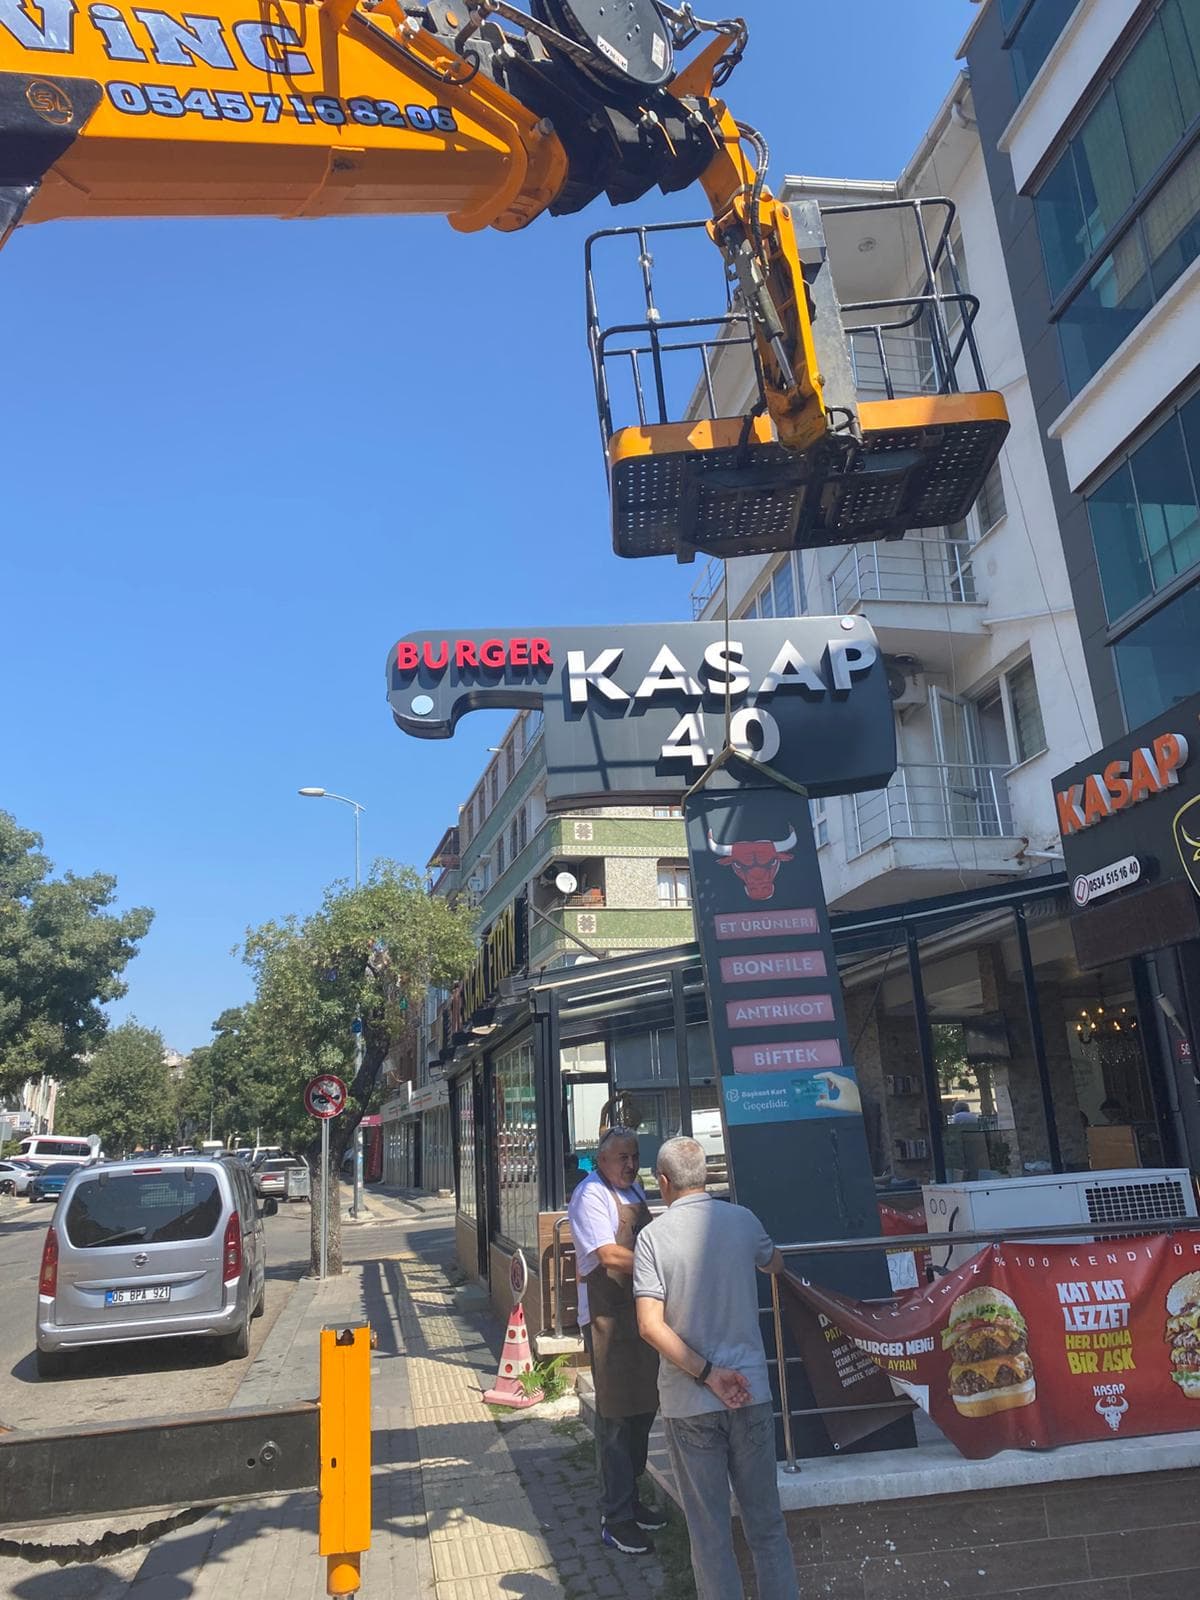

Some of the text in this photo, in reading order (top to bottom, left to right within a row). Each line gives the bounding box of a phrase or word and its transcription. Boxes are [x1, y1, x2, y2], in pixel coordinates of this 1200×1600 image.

[397, 637, 554, 671] BURGER
[565, 638, 879, 704] KASAP
[660, 706, 781, 767] 40
[1056, 732, 1188, 836] KASAP
[1106, 869, 1119, 885] 515
[1118, 865, 1128, 879] 16
[1129, 861, 1139, 875] 40
[719, 921, 737, 934] ET
[735, 1001, 825, 1021] ANTRİKOT
[753, 1047, 820, 1066] BİFTEK
[112, 1290, 124, 1302] 06
[153, 1287, 169, 1298] 921
[1056, 1279, 1127, 1304] KAT KAT
[1062, 1303, 1131, 1332] LEZZET
[1065, 1330, 1132, 1350] HER LOKMA
[887, 1359, 918, 1371] AYRAN
[1102, 1347, 1137, 1374] AŞK
[1092, 1383, 1126, 1397] KASAP
[1106, 1395, 1117, 1405] 40
